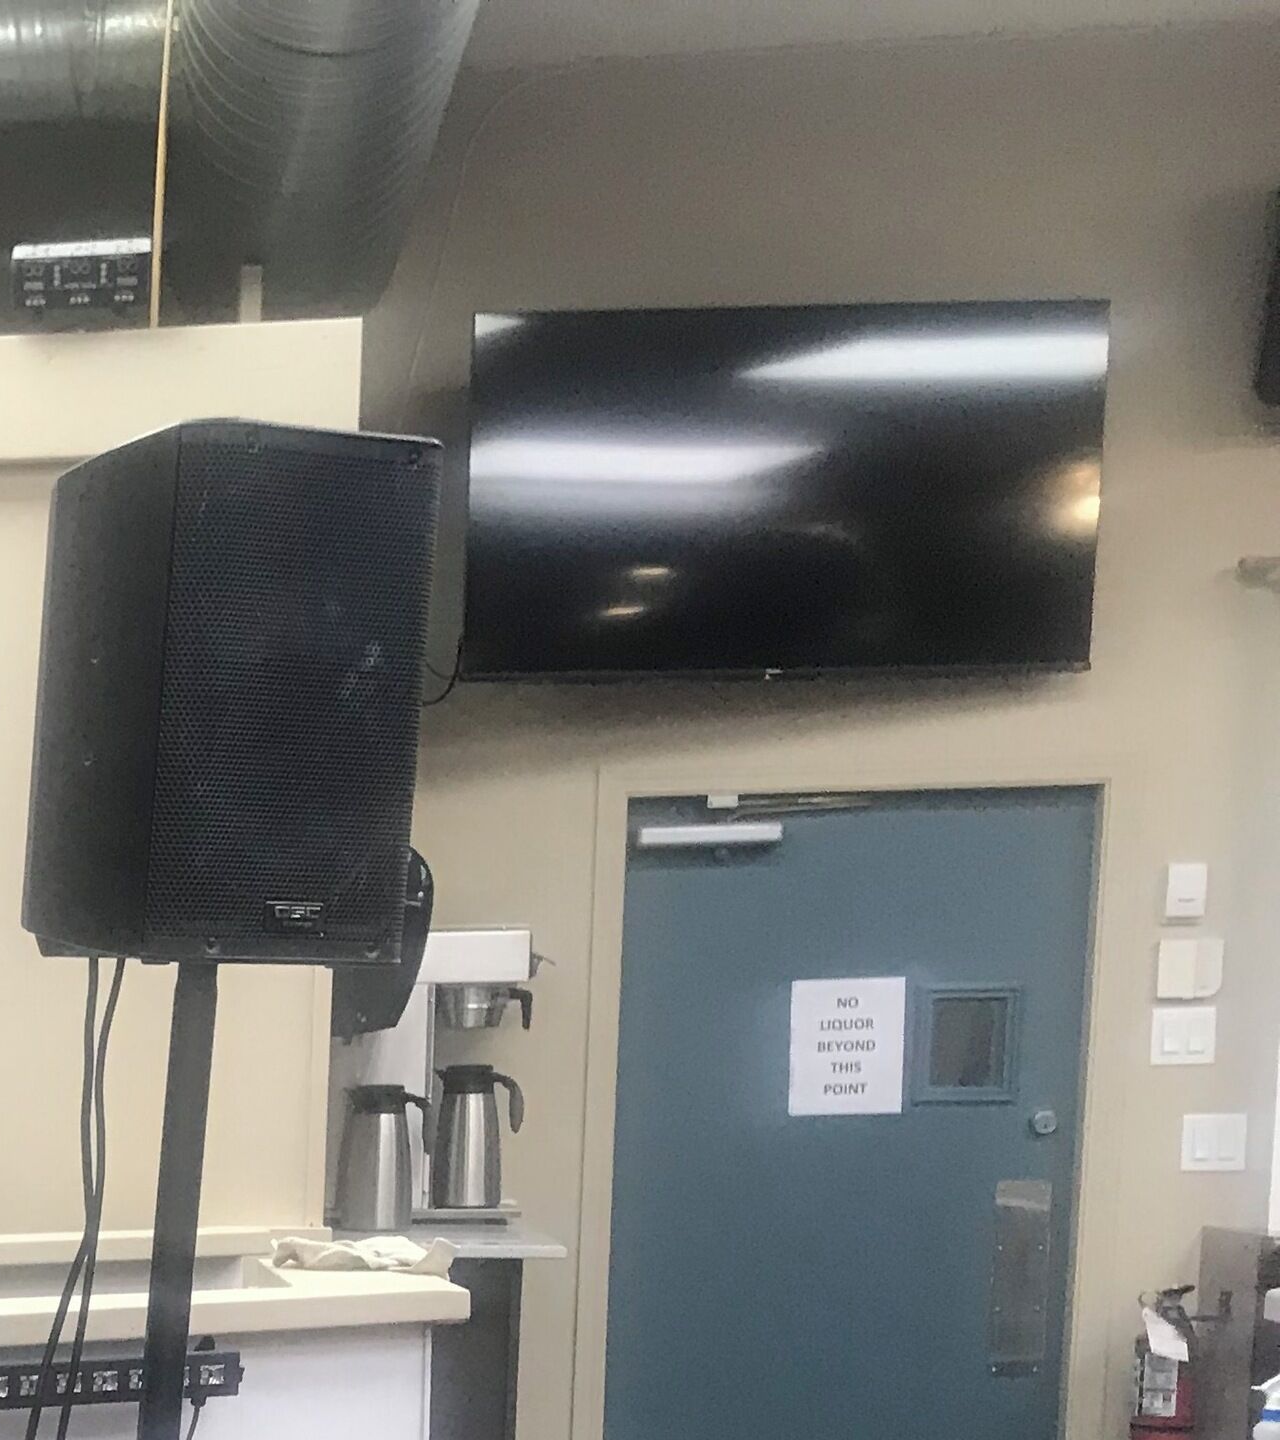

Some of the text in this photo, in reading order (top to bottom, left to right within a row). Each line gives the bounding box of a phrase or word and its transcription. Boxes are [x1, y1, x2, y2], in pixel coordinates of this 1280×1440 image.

[836, 997, 859, 1009] NO
[820, 1018, 875, 1031] LIQUOR
[817, 1039, 877, 1053] BEYOND
[831, 1061, 862, 1074] THIS
[823, 1082, 868, 1096] POINT
